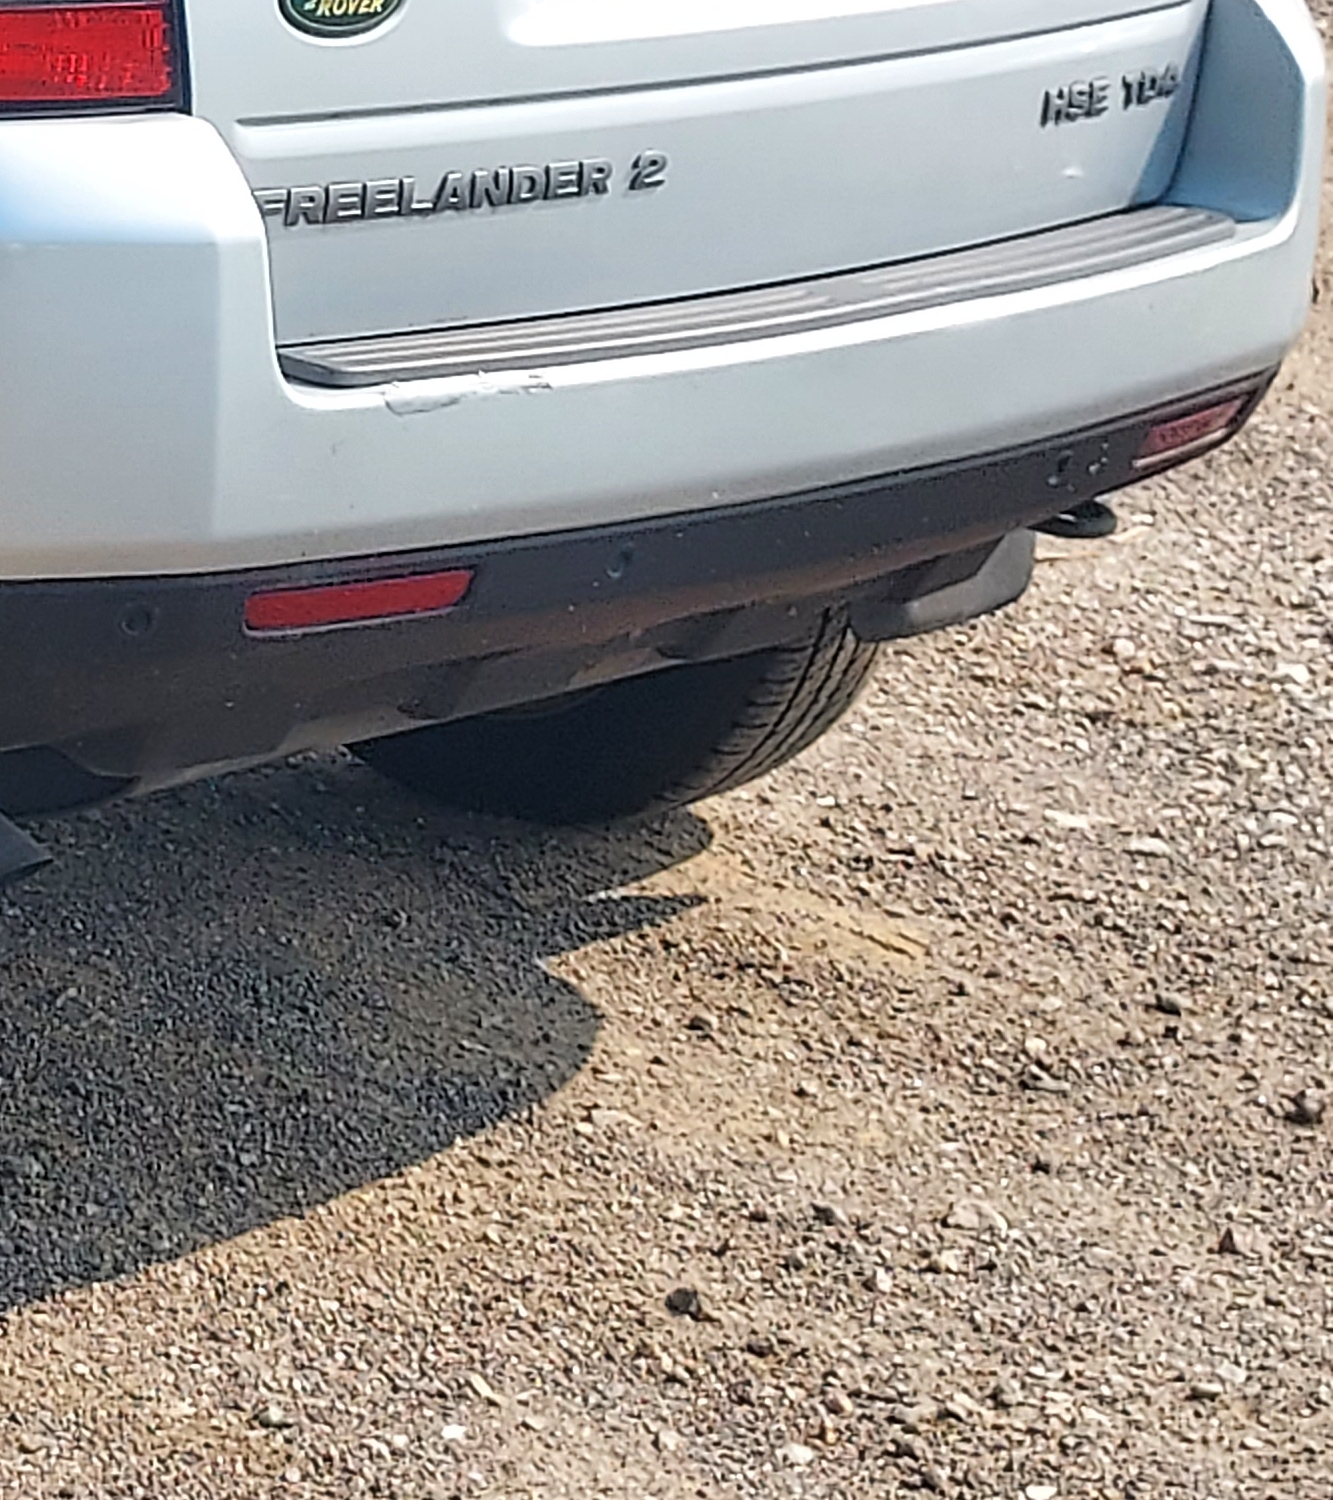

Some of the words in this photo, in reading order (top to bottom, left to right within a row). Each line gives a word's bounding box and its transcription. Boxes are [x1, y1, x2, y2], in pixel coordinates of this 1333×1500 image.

[1039, 75, 1111, 127] HSE
[251, 157, 613, 228] FREELANDER
[627, 148, 669, 193] 2
